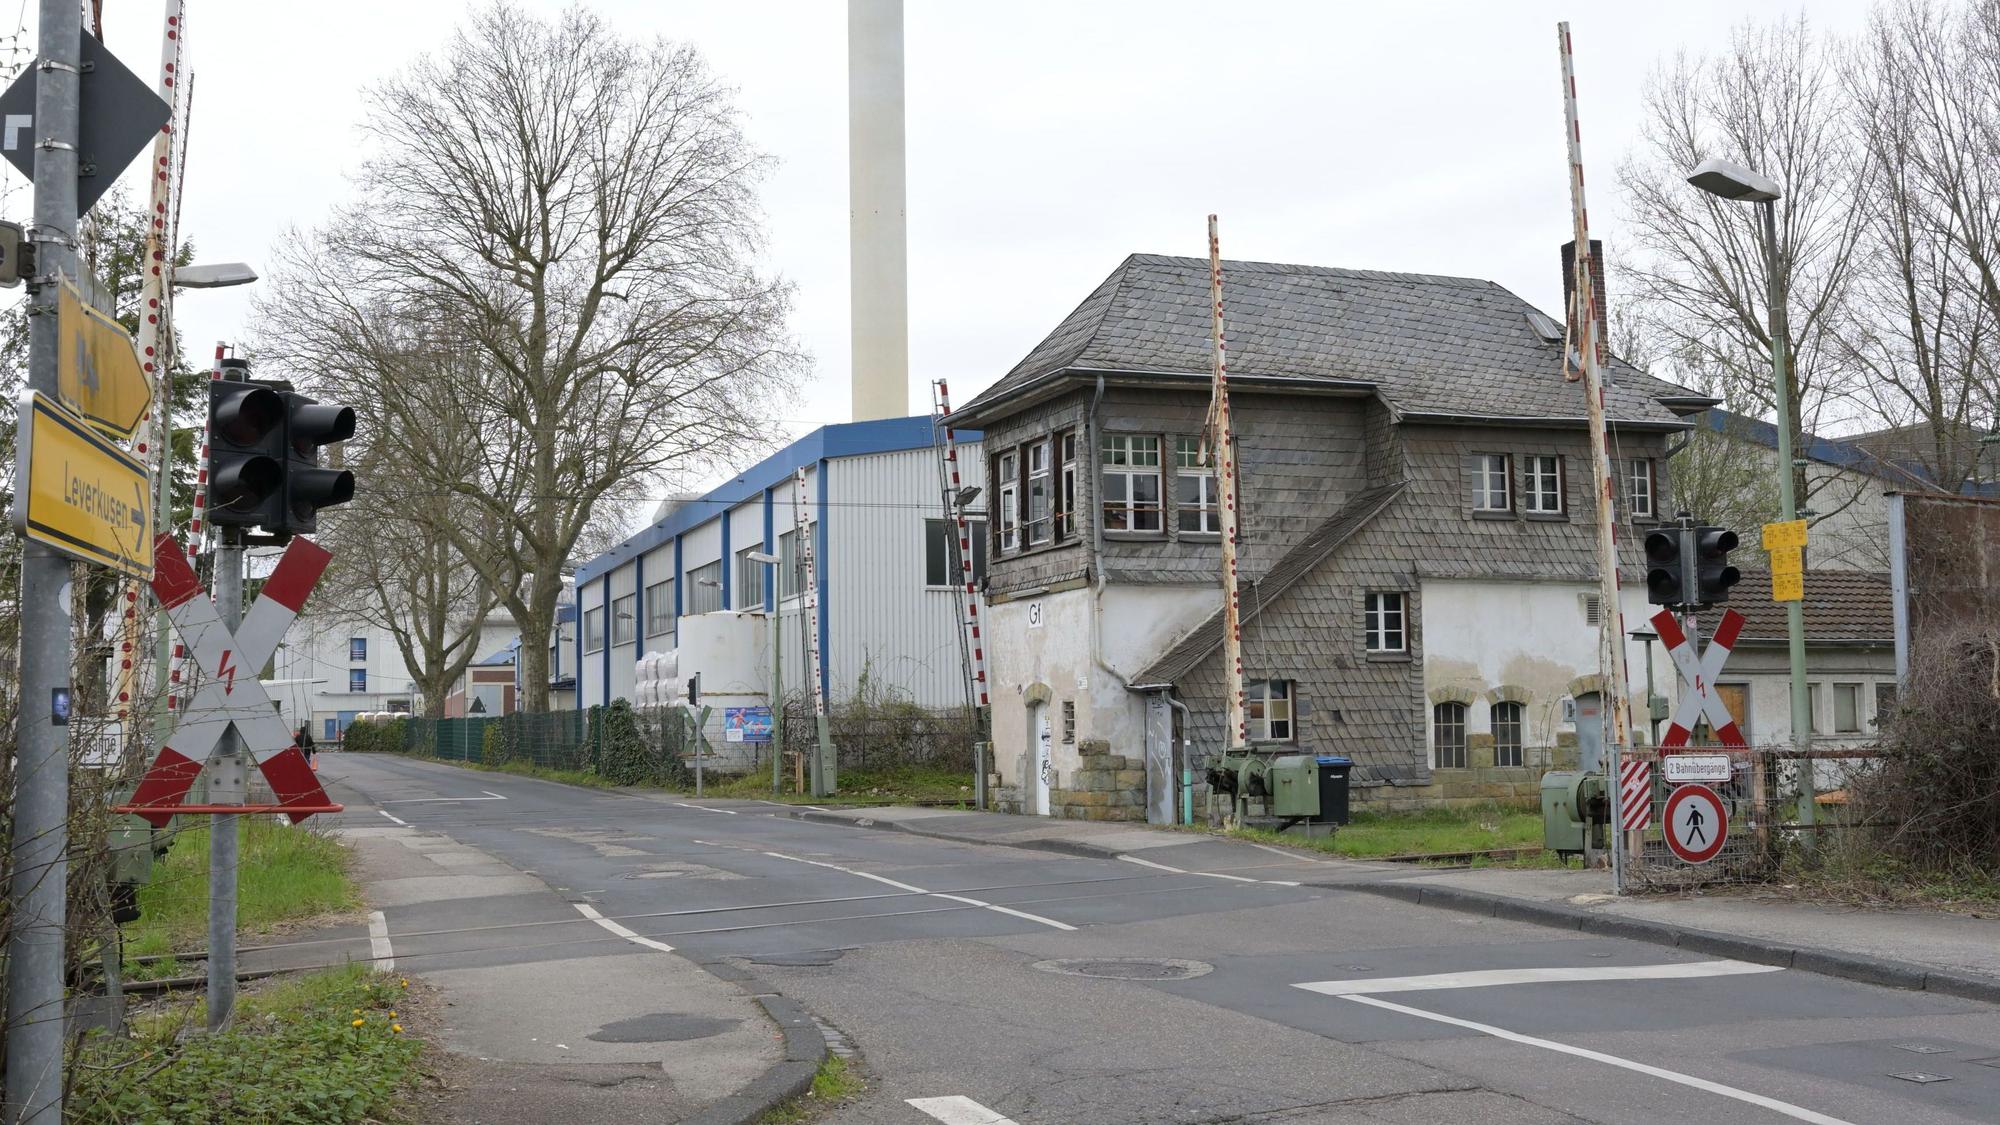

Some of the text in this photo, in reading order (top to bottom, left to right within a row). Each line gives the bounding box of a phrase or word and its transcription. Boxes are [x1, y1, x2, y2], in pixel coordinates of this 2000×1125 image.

[64, 456, 128, 530] Leverkusen
[1029, 602, 1041, 625] Gf
[1669, 761, 1726, 775] 2 Bahnübergänge
